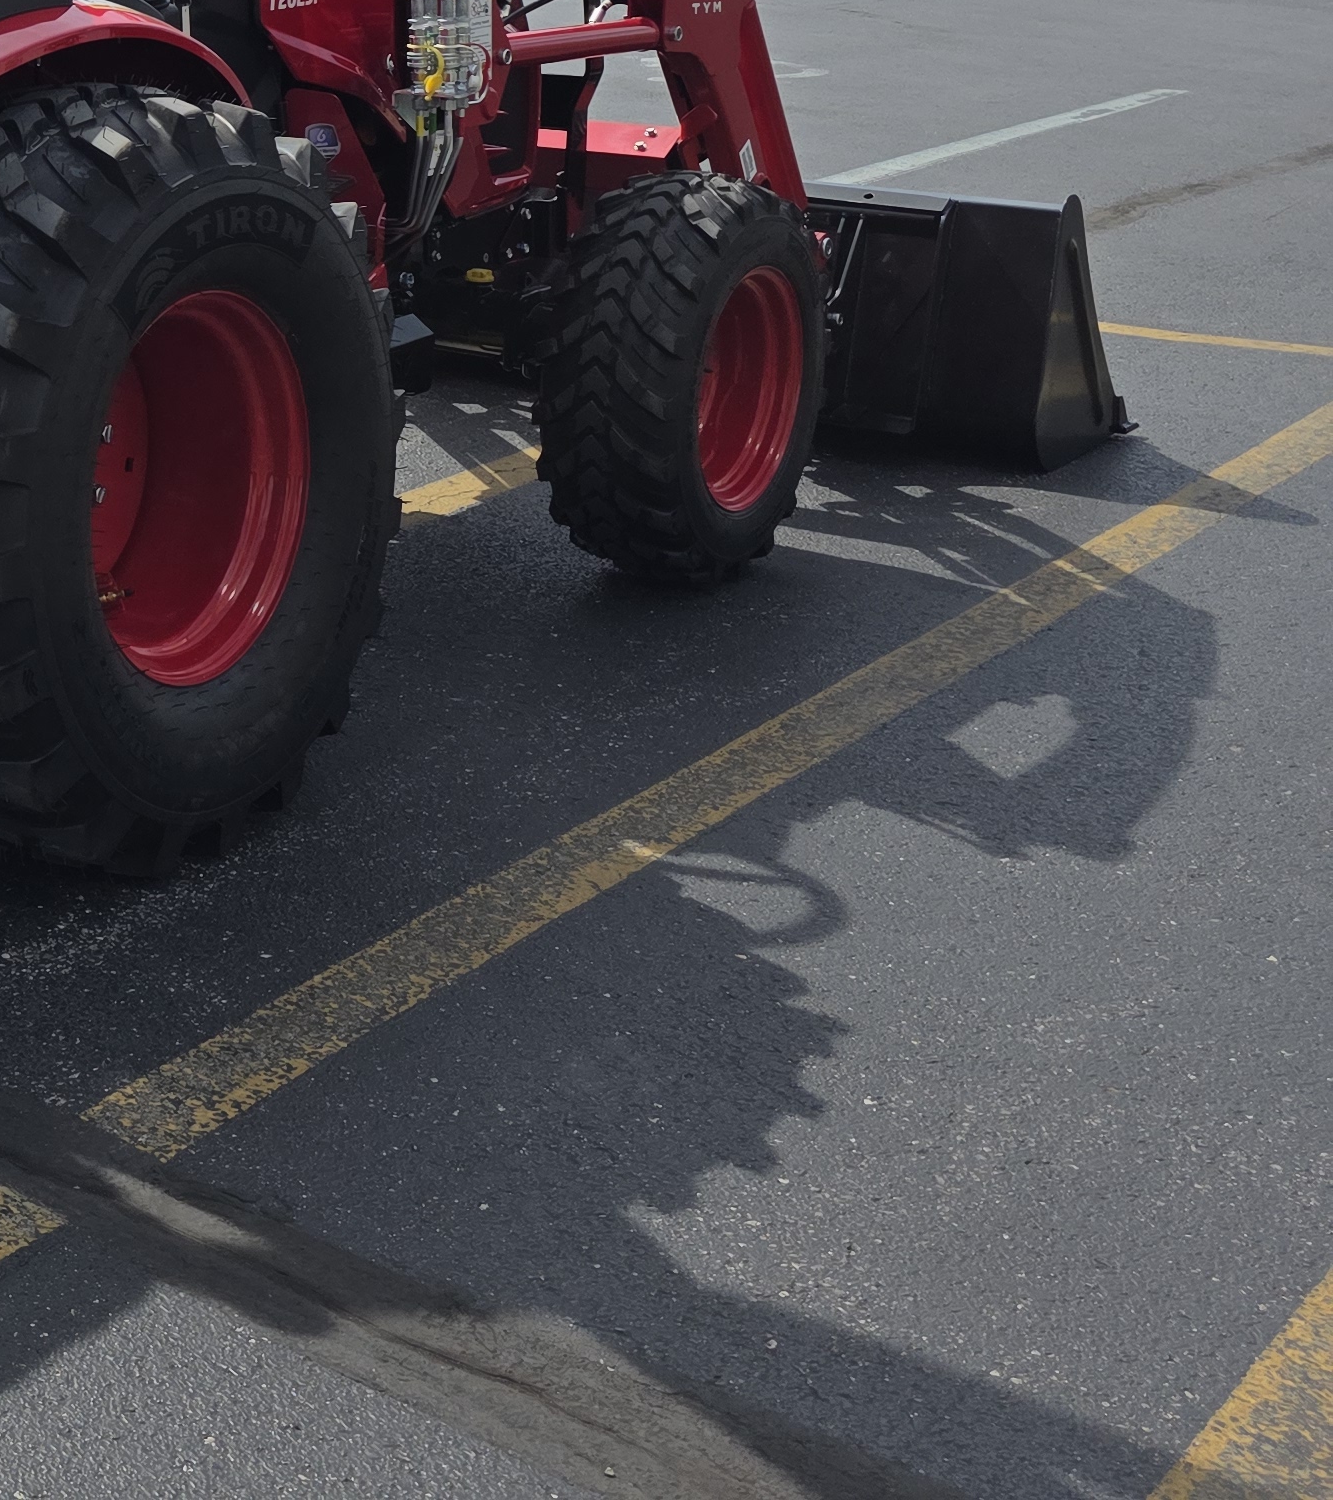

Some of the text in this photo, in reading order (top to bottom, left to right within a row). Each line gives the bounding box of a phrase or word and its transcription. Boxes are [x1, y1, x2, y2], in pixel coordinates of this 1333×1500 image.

[692, 1, 722, 15] TYM
[316, 129, 326, 142] 6
[185, 204, 307, 249] TIRON
